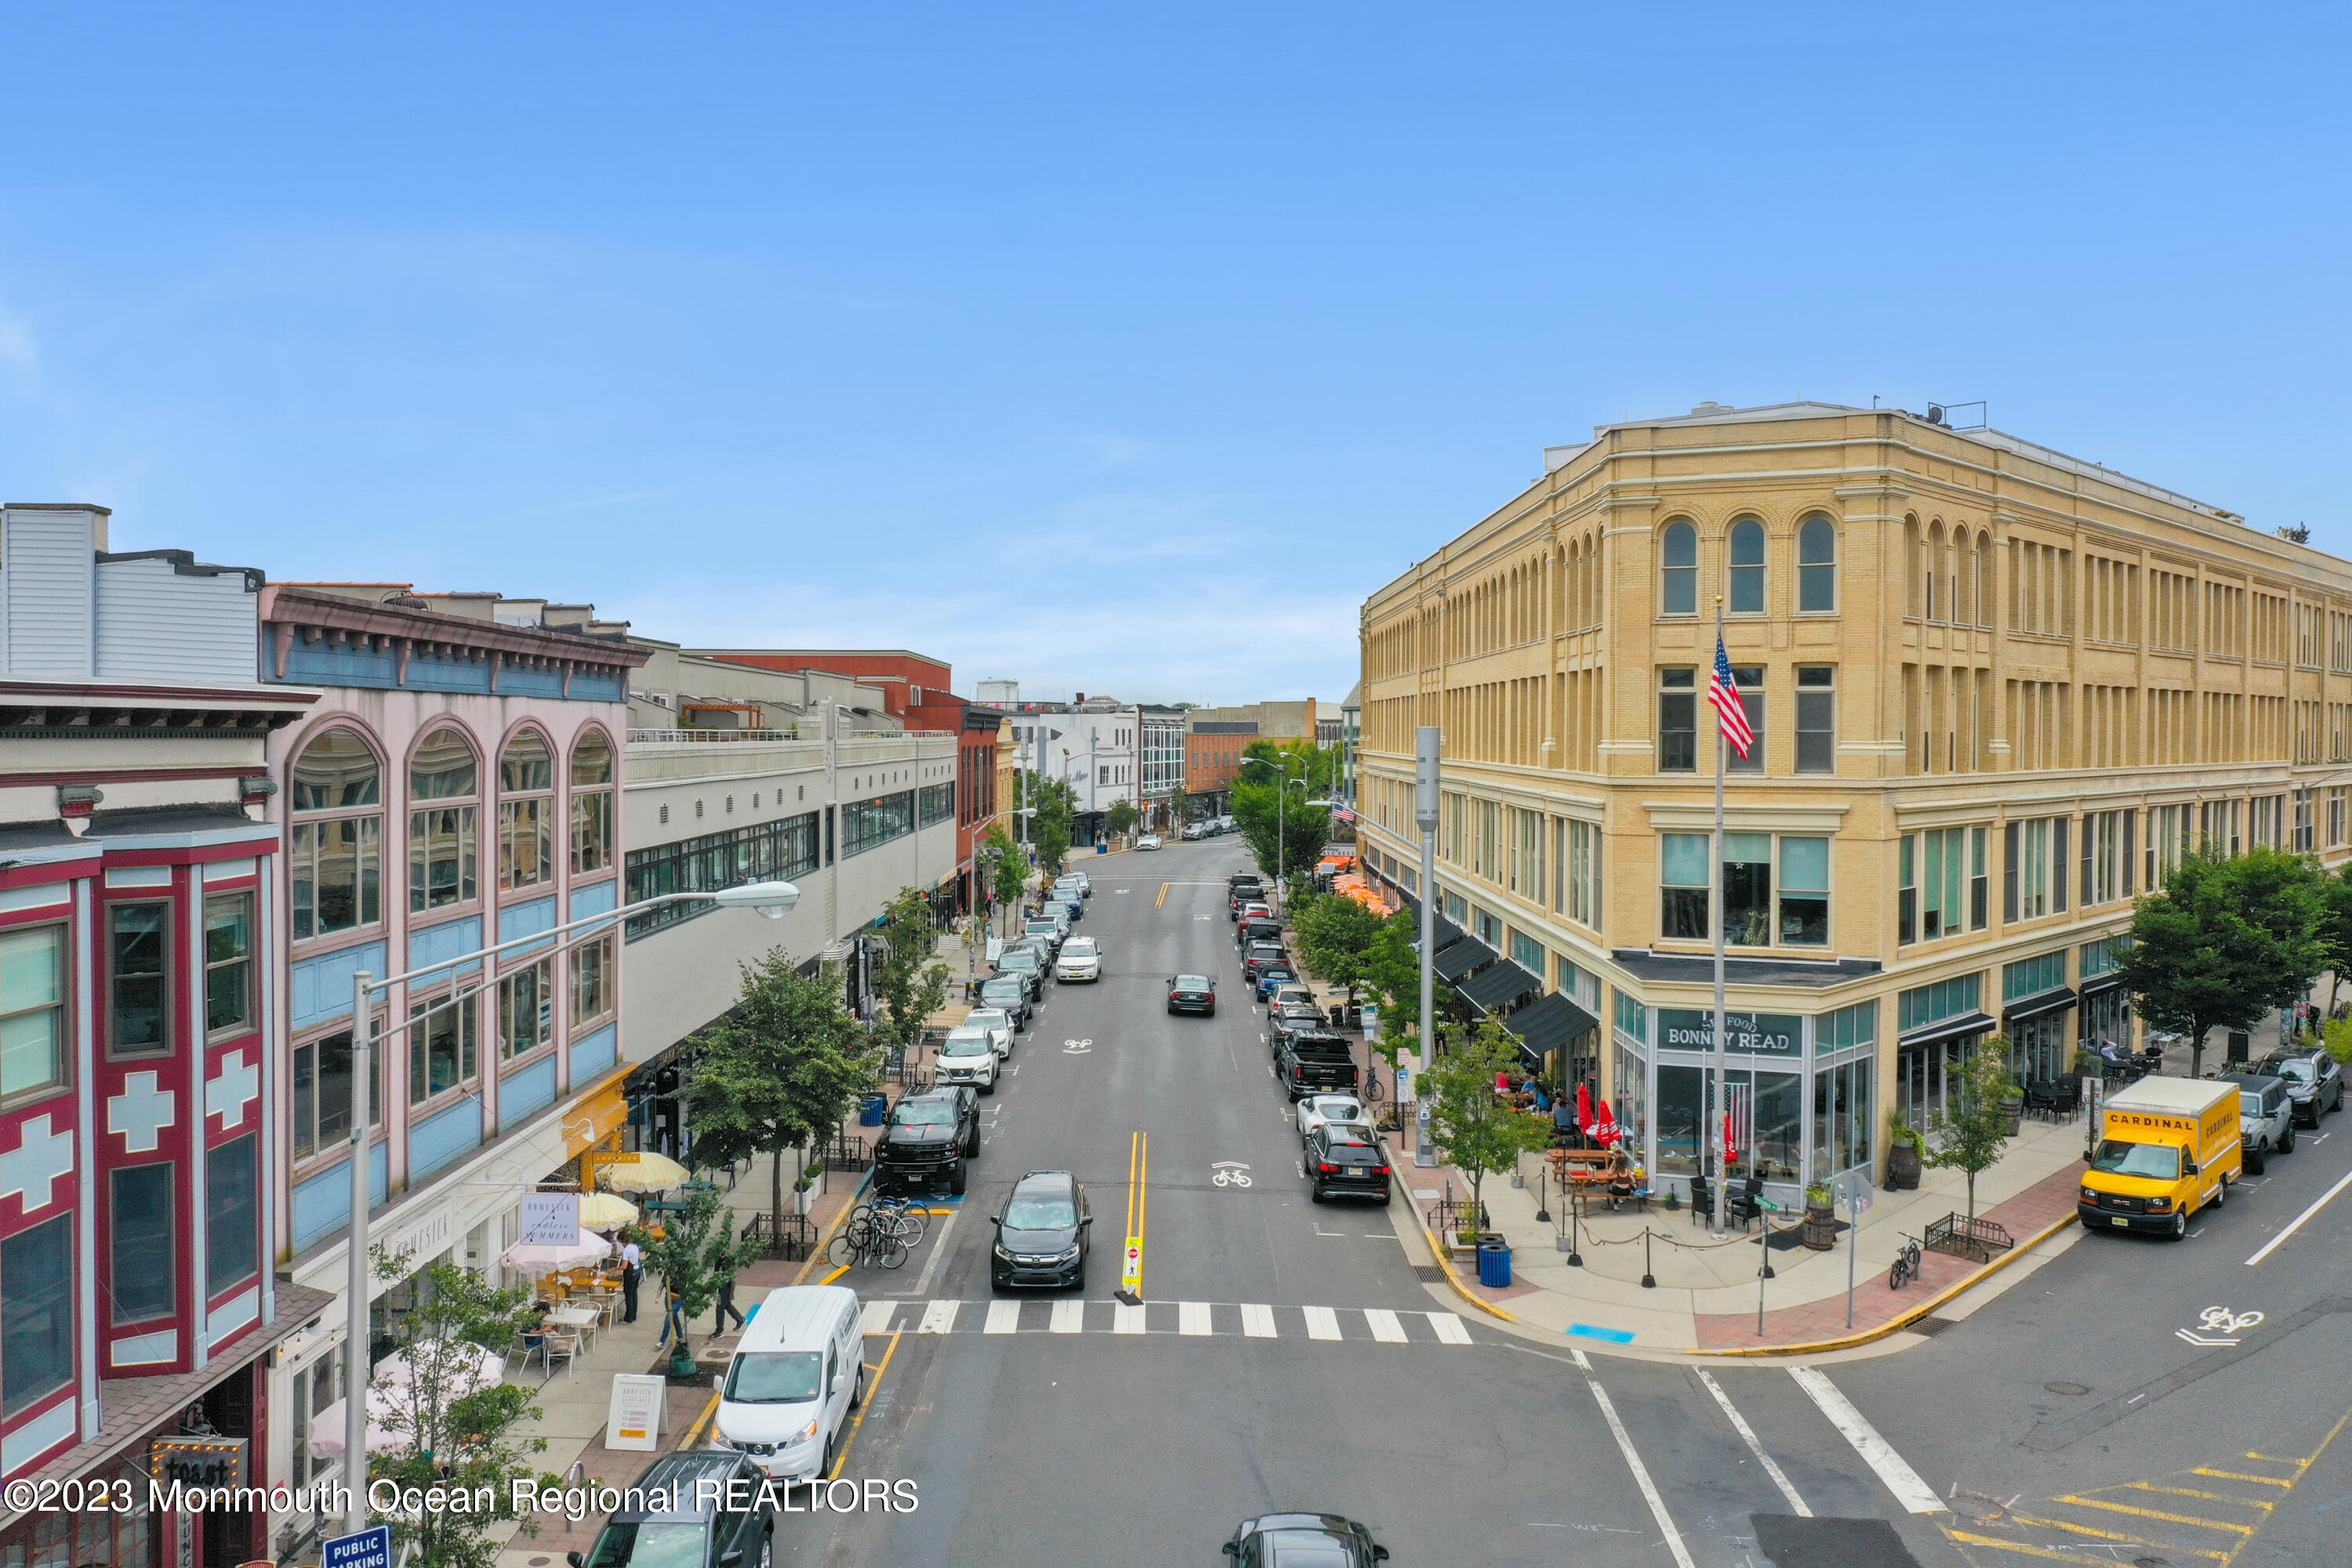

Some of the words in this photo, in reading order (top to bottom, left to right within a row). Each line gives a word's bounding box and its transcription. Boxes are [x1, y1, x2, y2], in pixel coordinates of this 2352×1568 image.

[1701, 1016, 1758, 1033] SEFOOD
[1668, 1029, 1735, 1047] BONNY
[1738, 1033, 1790, 1050] READ
[2110, 1114, 2194, 1131] CARDINAL
[2206, 1112, 2233, 1138] CARDINAL
[165, 1457, 229, 1486] toast
[333, 1537, 379, 1560] PUBLIC
[330, 1552, 385, 1568] RKING
